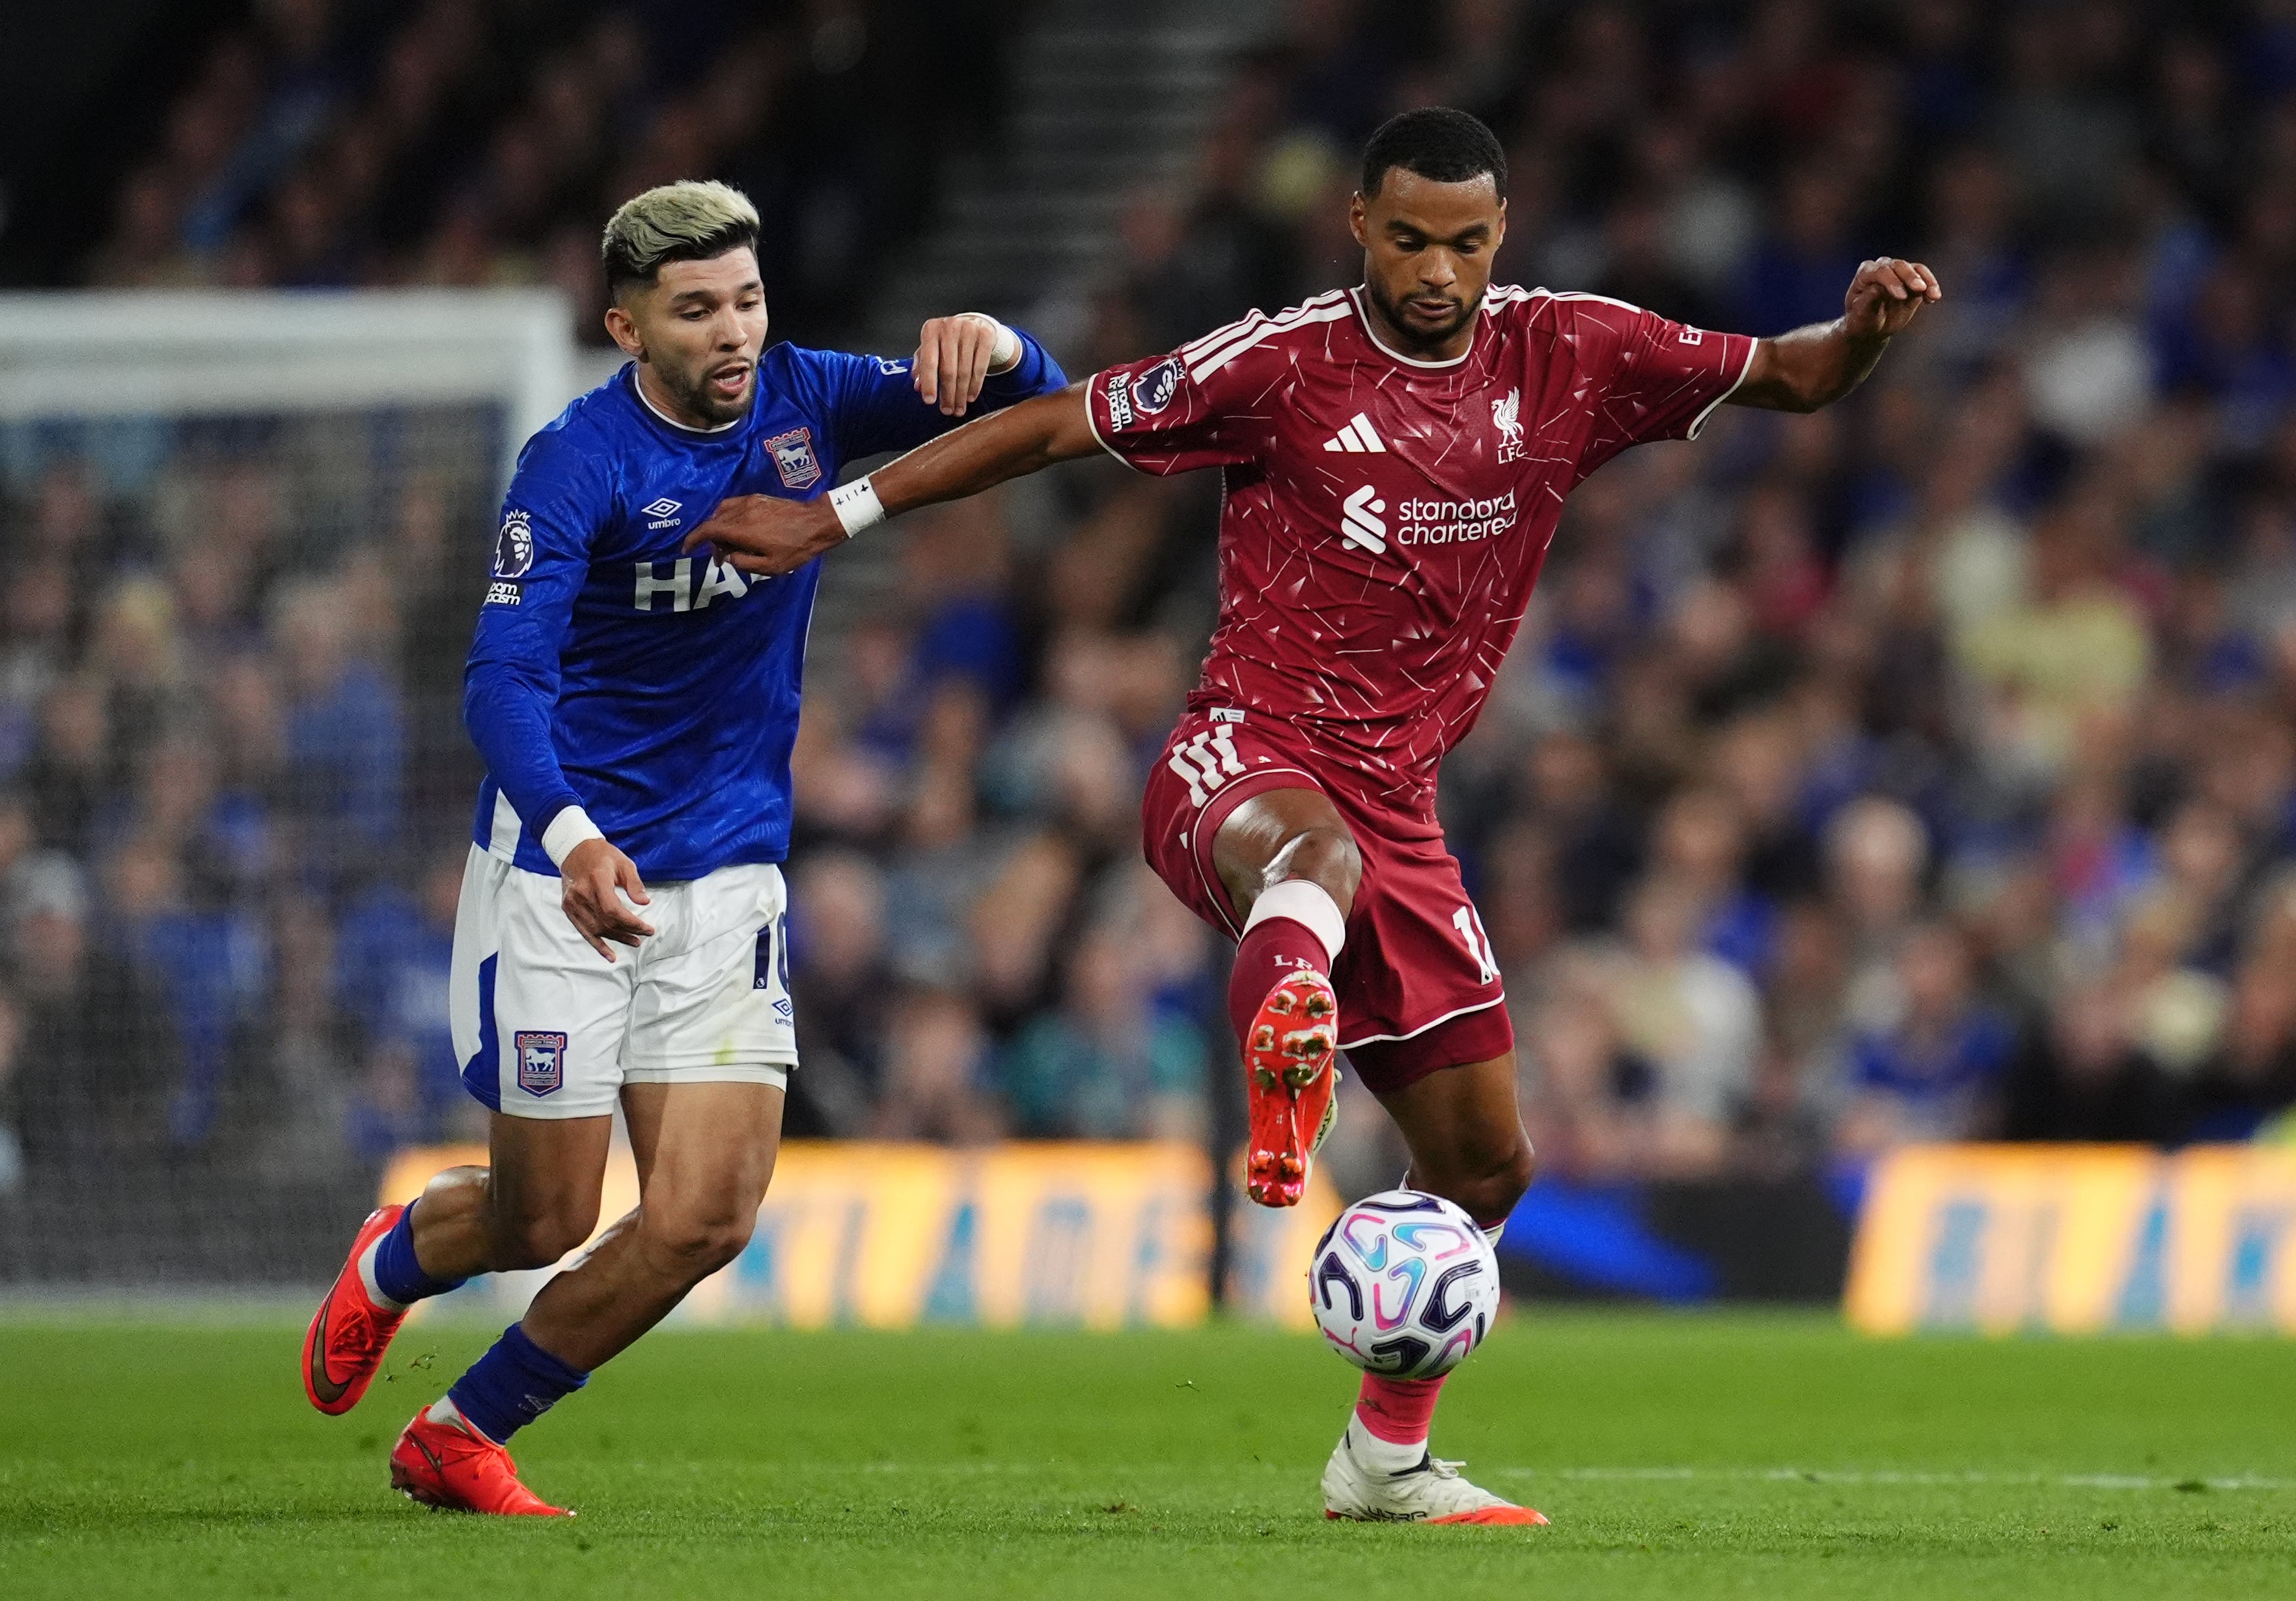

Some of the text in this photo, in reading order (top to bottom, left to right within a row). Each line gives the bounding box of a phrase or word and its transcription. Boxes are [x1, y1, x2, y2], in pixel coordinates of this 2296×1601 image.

[1108, 376, 1122, 433] for racism
[1117, 372, 1133, 424] No room
[1399, 487, 1516, 522] standard
[648, 518, 681, 529] umbro
[1398, 507, 1519, 546] chartered
[482, 593, 521, 607] acism
[488, 583, 518, 595] oom
[635, 557, 794, 612] HA
